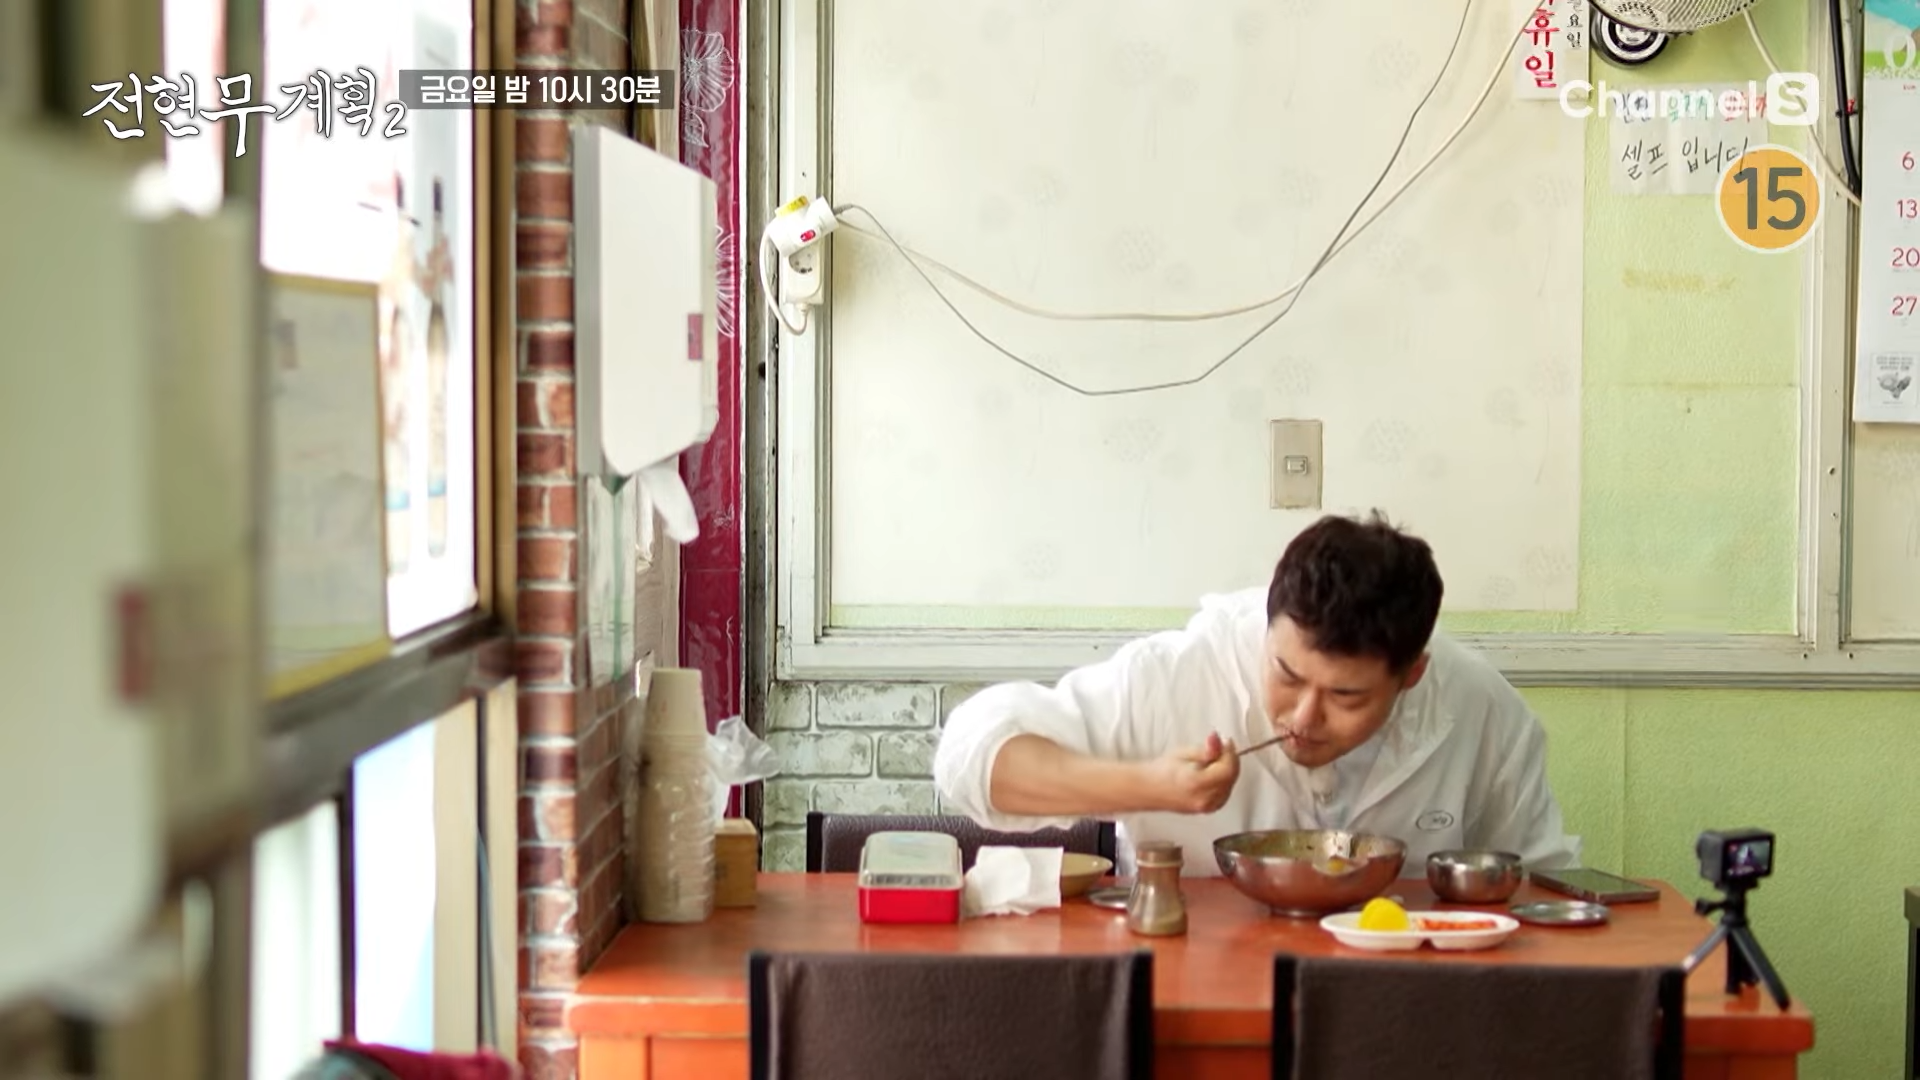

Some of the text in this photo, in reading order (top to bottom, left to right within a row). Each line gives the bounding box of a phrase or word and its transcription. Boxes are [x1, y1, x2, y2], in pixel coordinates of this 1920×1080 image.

[1523, 0, 1560, 88] 휴일
[1621, 136, 1757, 180] 셀프 입니다
[1902, 151, 1915, 171] 6
[1896, 199, 1918, 219] 13
[1891, 247, 1920, 267] 20
[1891, 295, 1918, 316] 27
